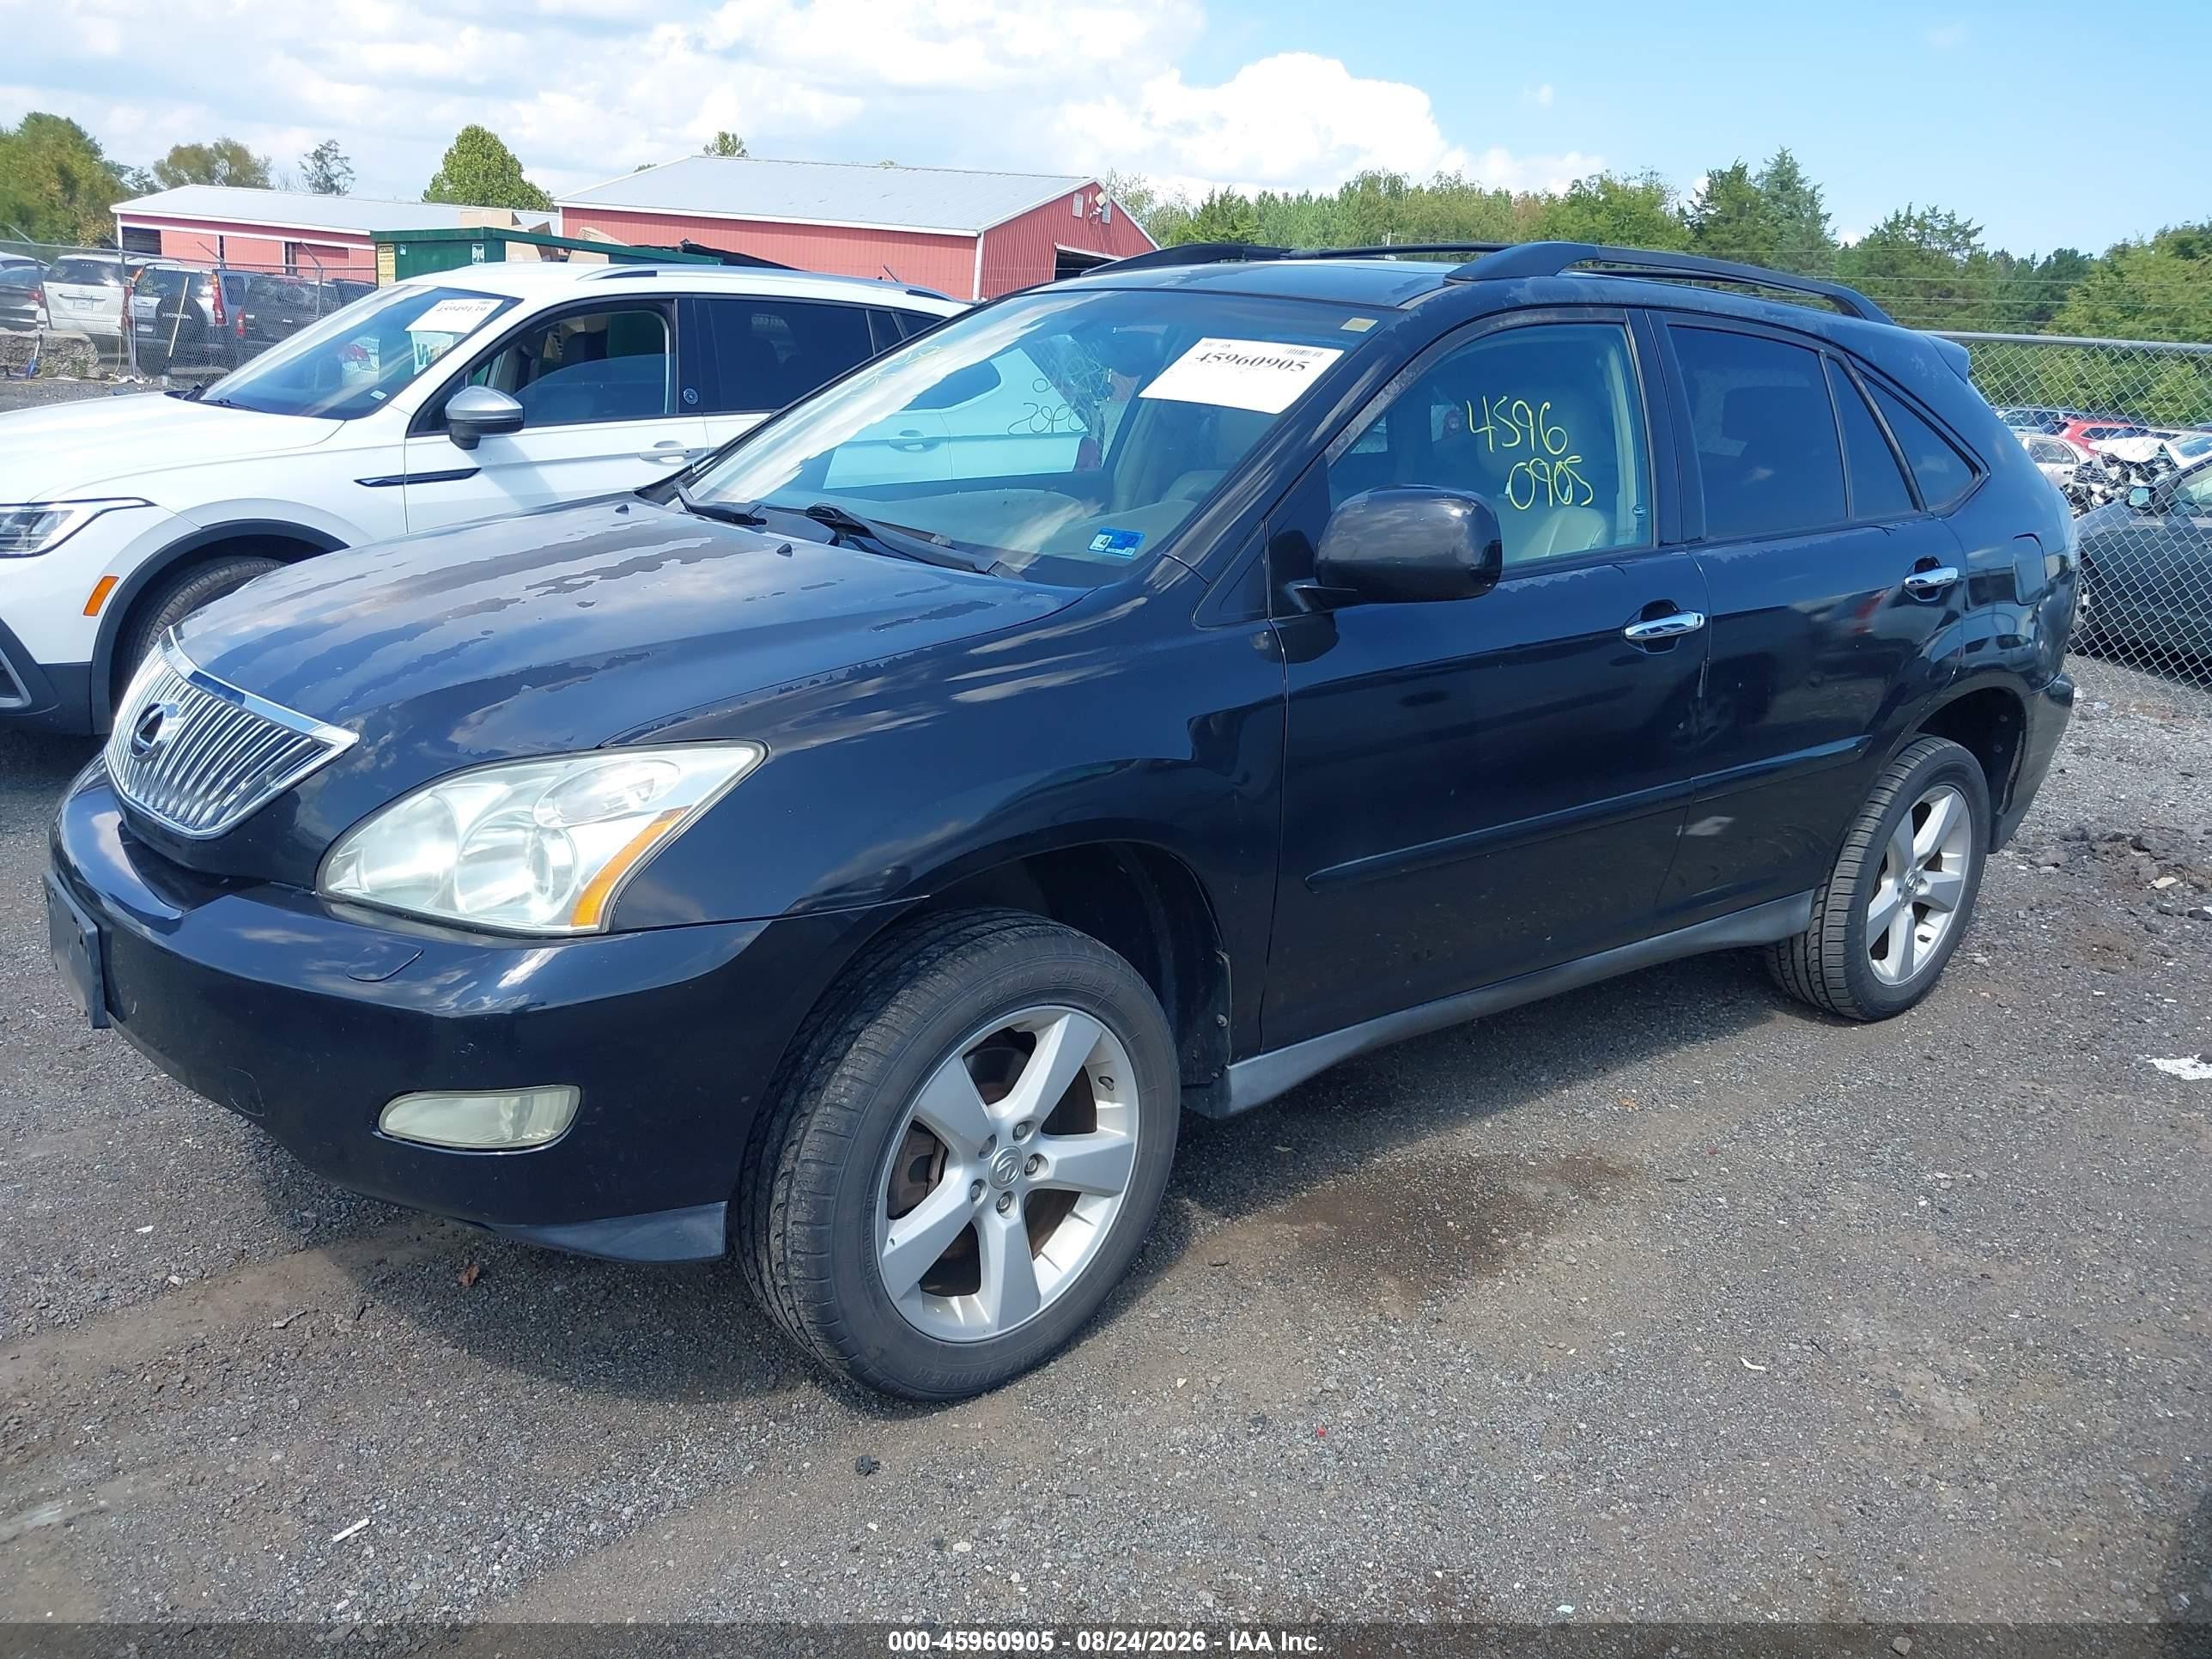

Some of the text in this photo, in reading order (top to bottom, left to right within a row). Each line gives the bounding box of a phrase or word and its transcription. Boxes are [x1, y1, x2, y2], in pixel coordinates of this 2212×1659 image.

[1194, 352, 1311, 373] 45960905
[1466, 395, 1568, 455] 4596
[1508, 455, 1595, 510] 0905
